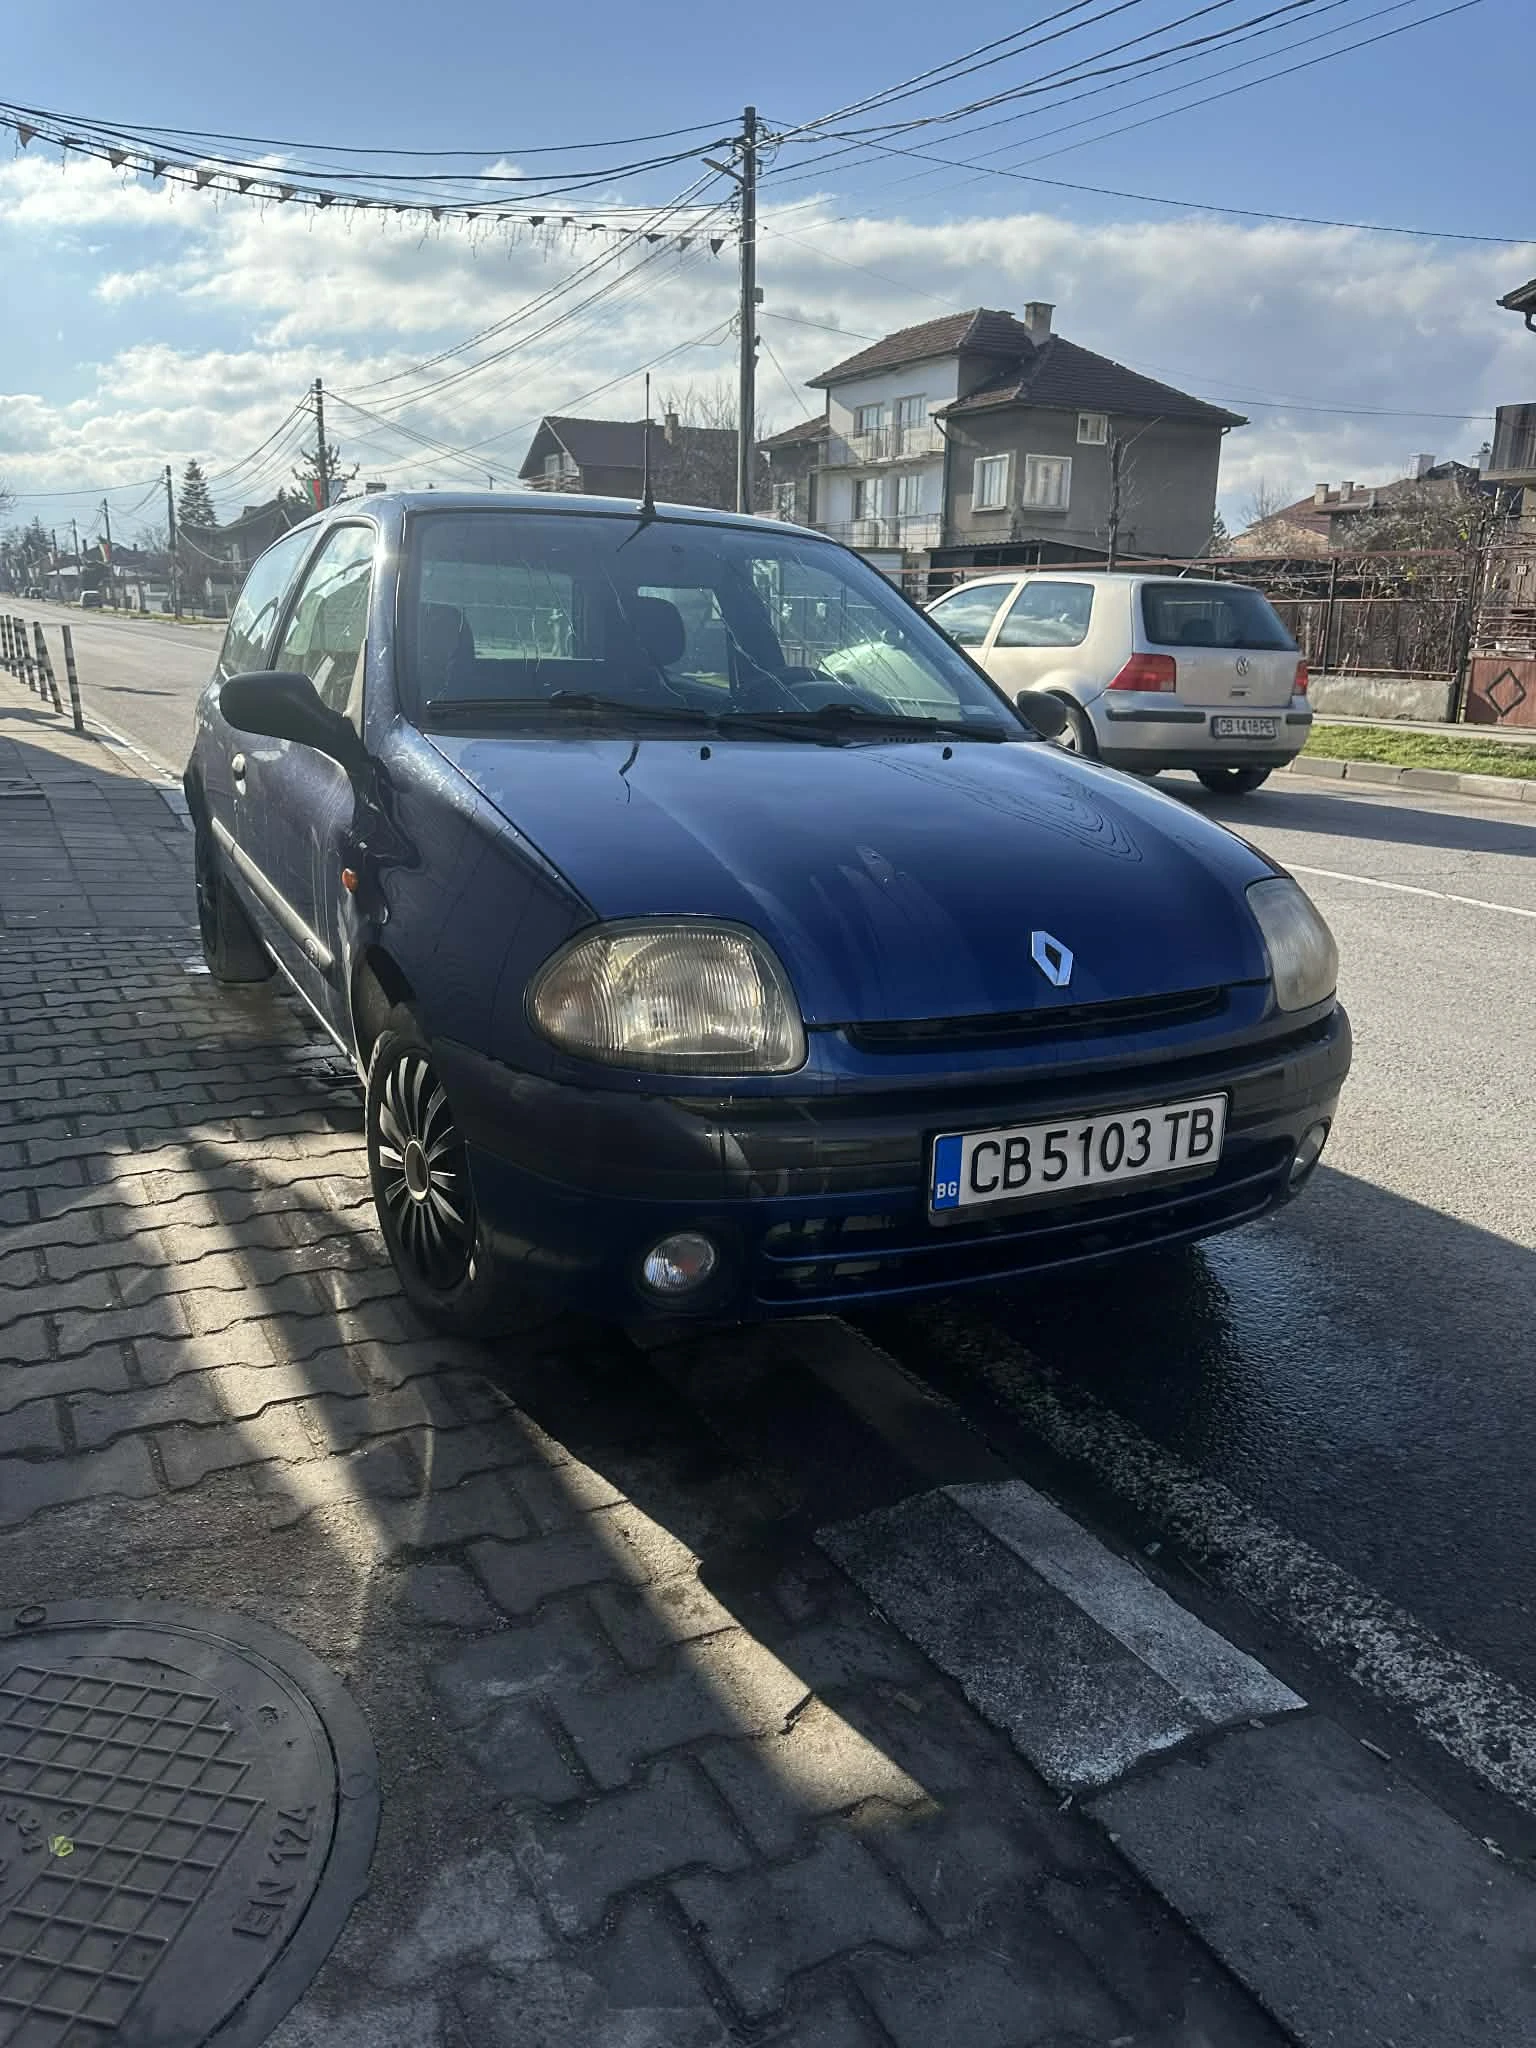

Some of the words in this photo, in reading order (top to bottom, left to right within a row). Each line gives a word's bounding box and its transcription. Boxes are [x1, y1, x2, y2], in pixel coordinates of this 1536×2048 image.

[936, 1180, 958, 1199] BG
[970, 1137, 1032, 1193] CB
[1042, 1118, 1151, 1182] 5103
[1164, 1107, 1214, 1161] TB
[232, 1880, 297, 1938] EN
[268, 1804, 317, 1866] 124
